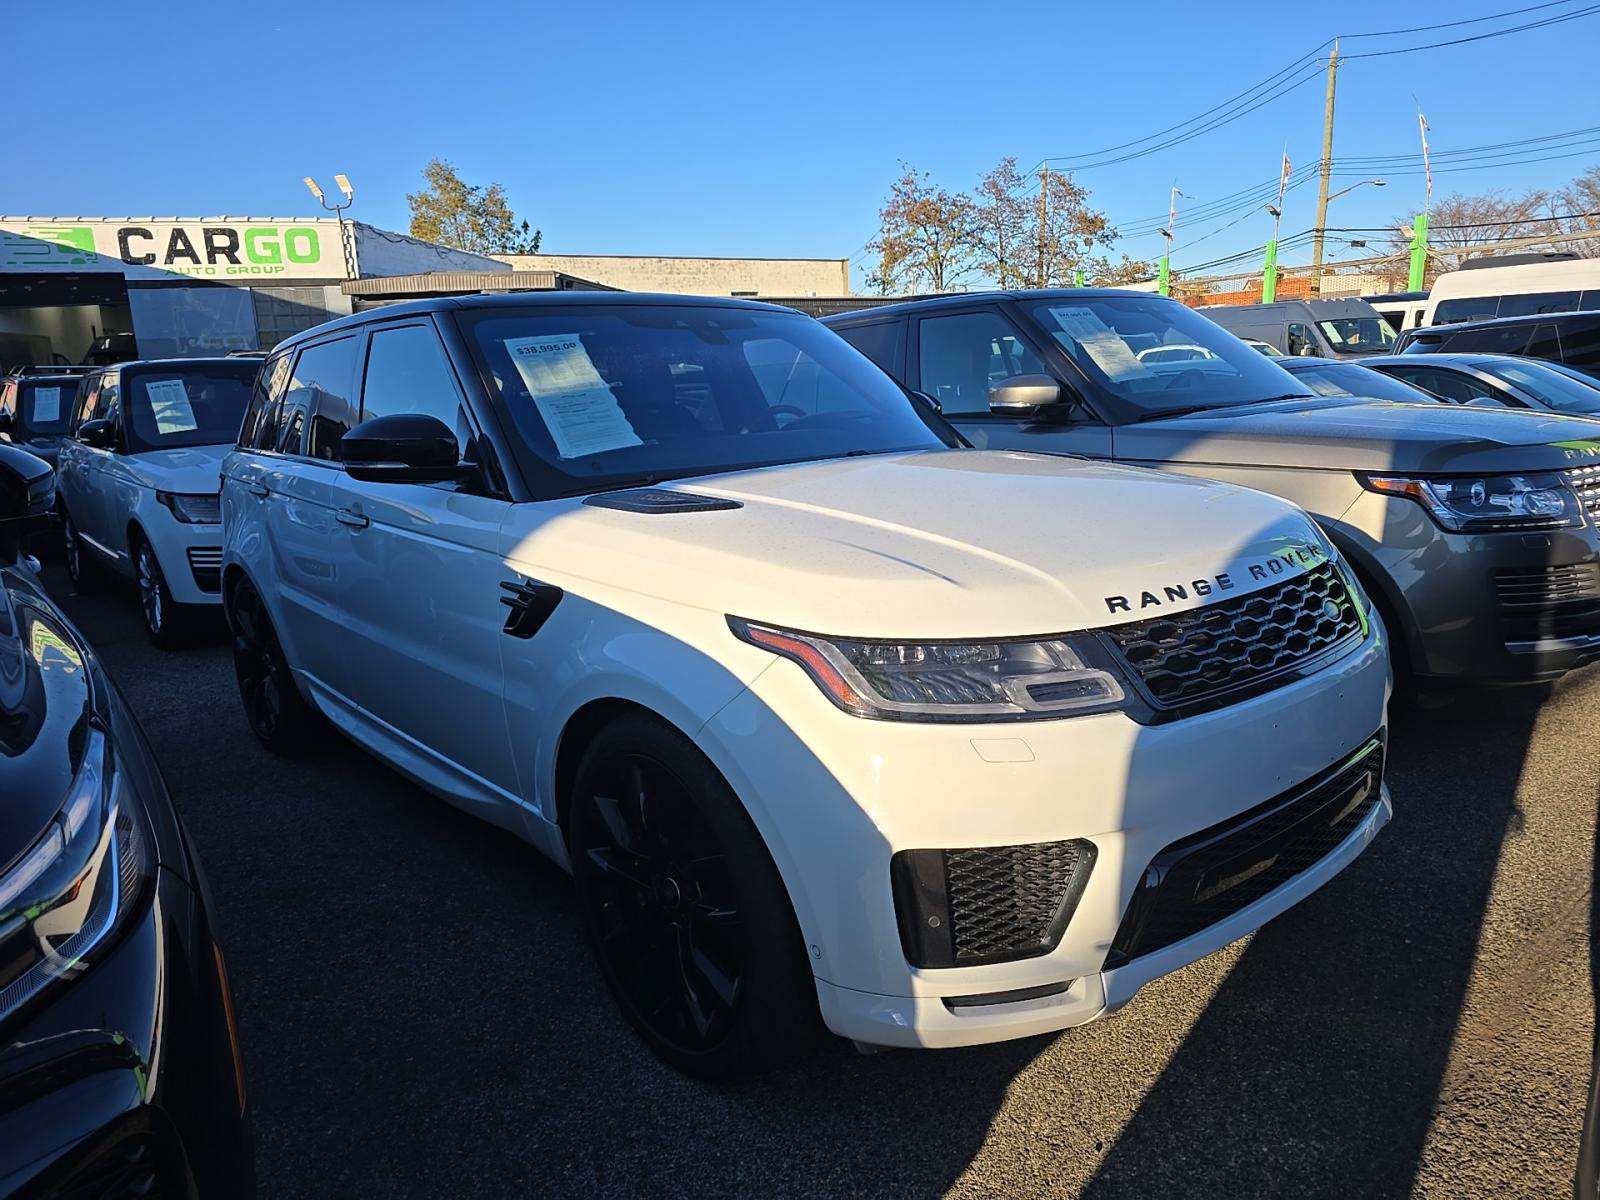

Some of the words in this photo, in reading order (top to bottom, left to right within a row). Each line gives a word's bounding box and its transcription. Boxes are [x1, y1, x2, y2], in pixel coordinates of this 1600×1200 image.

[117, 227, 320, 265] CARGO
[167, 266, 216, 274] AUTO
[226, 266, 285, 274] GROUP
[516, 342, 577, 354] $38,995.00
[1104, 573, 1234, 613] RANGE
[1248, 545, 1322, 580] ROVER
